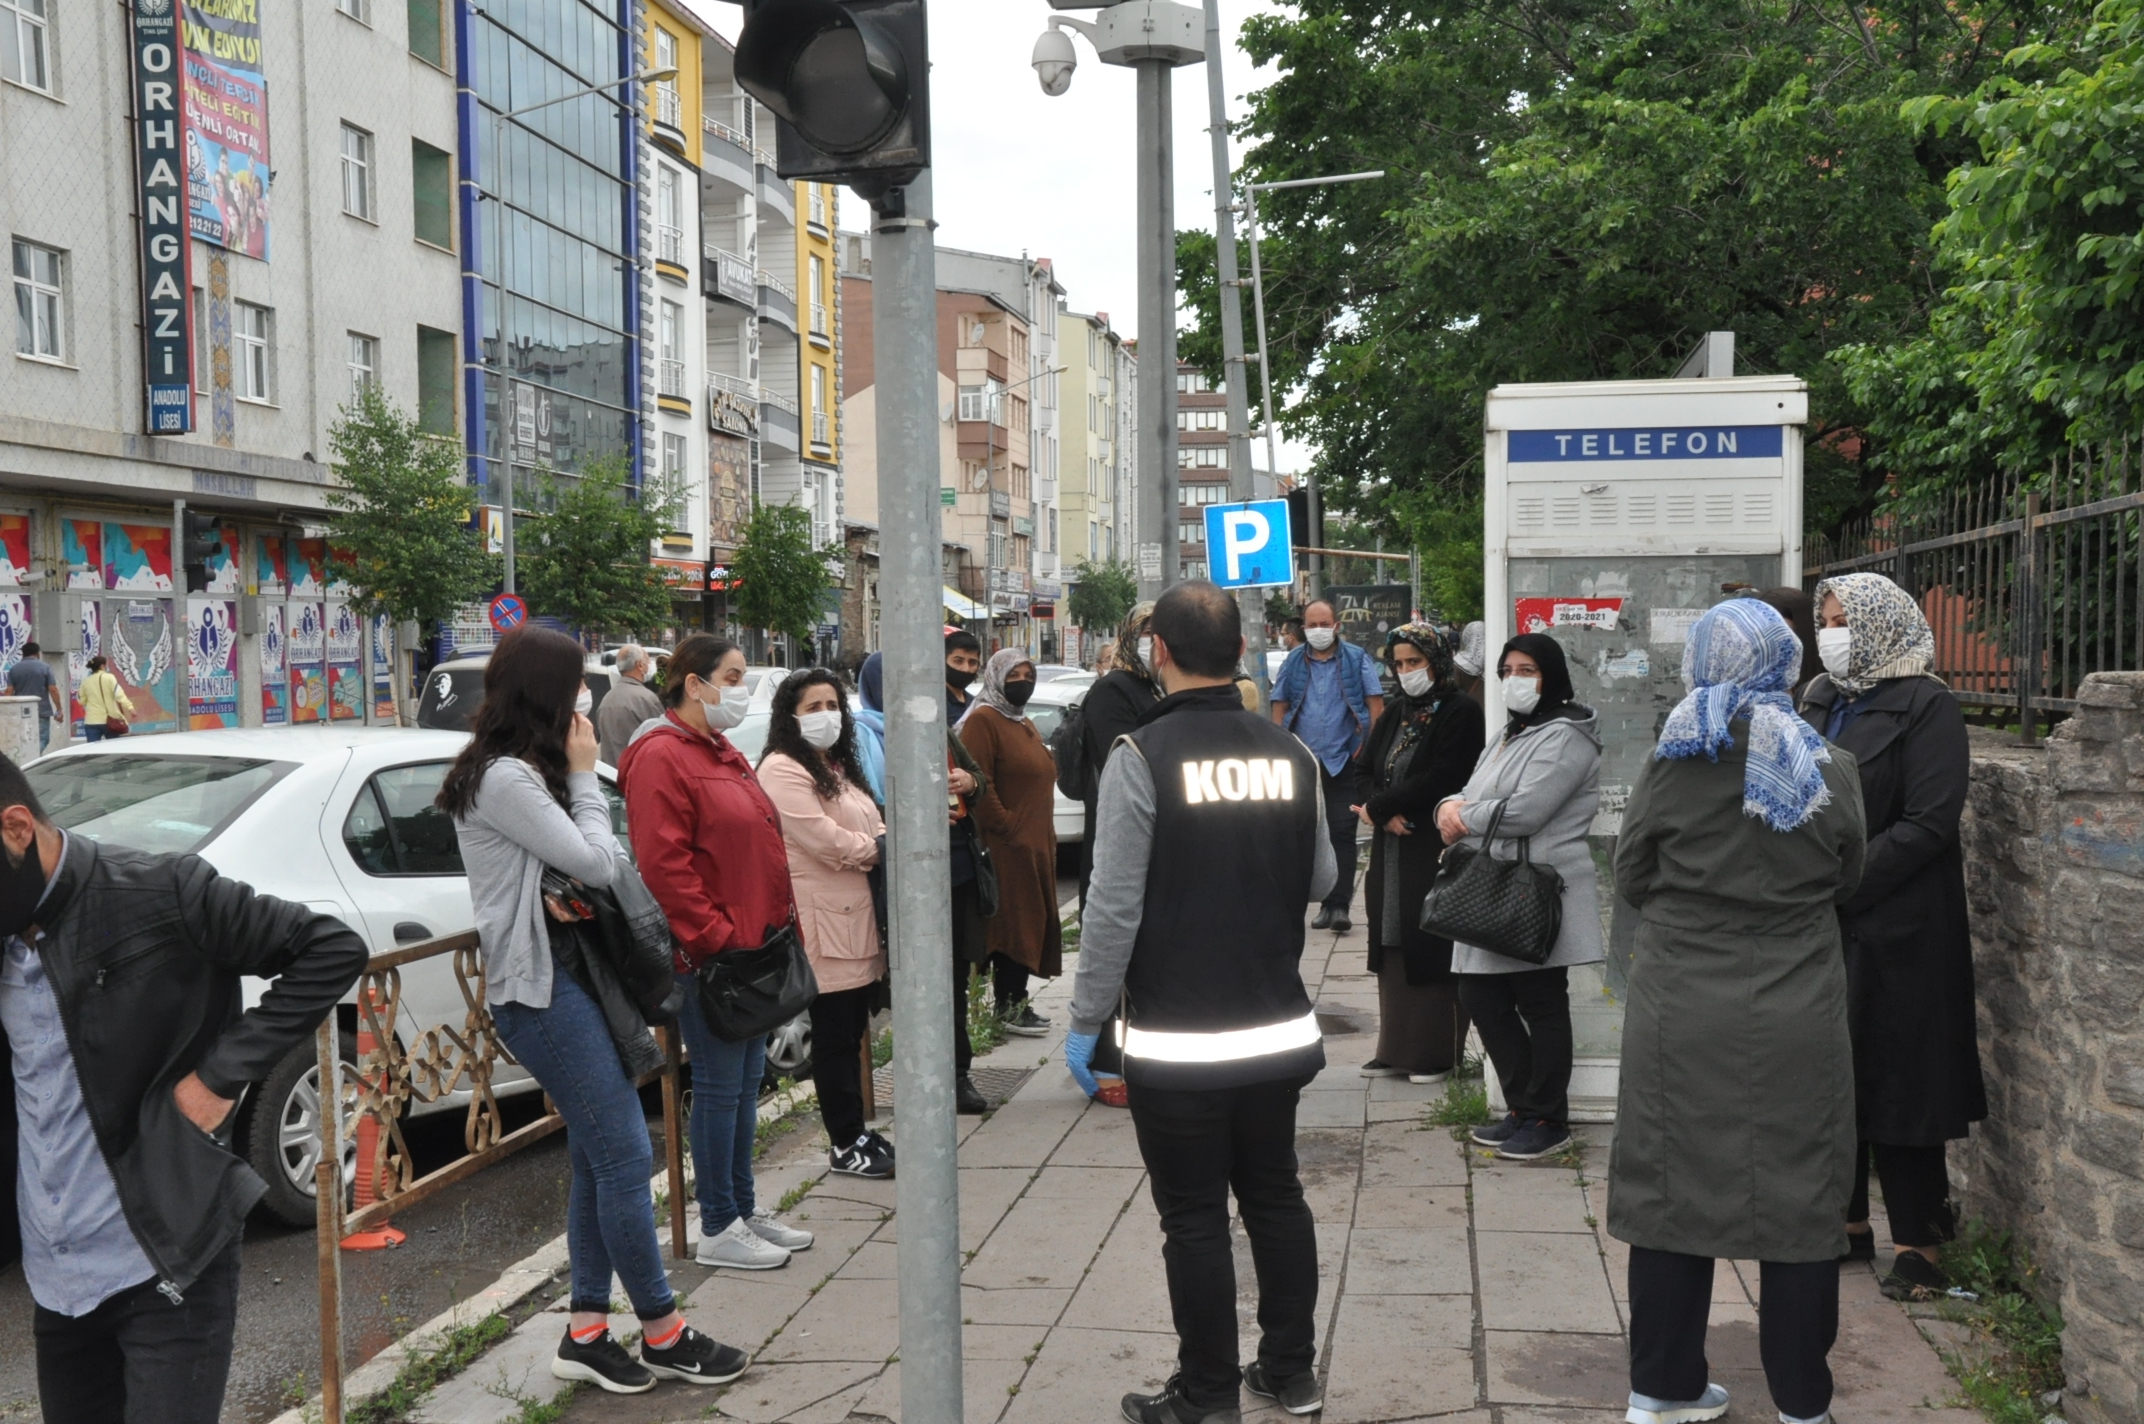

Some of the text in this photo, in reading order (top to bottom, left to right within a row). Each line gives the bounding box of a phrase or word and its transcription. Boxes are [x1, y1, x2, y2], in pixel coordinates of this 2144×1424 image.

[142, 43, 181, 374] ORHANGAZİ
[728, 260, 752, 286] AVUKAT
[153, 390, 186, 405] ANADOLU
[159, 410, 181, 429] LİSESİ
[1554, 431, 1738, 456] TELEFON
[1223, 510, 1270, 580] P
[1559, 613, 1606, 621] 2020-2021
[214, 702, 234, 713] LİSESİ
[1182, 758, 1294, 803] KOM
